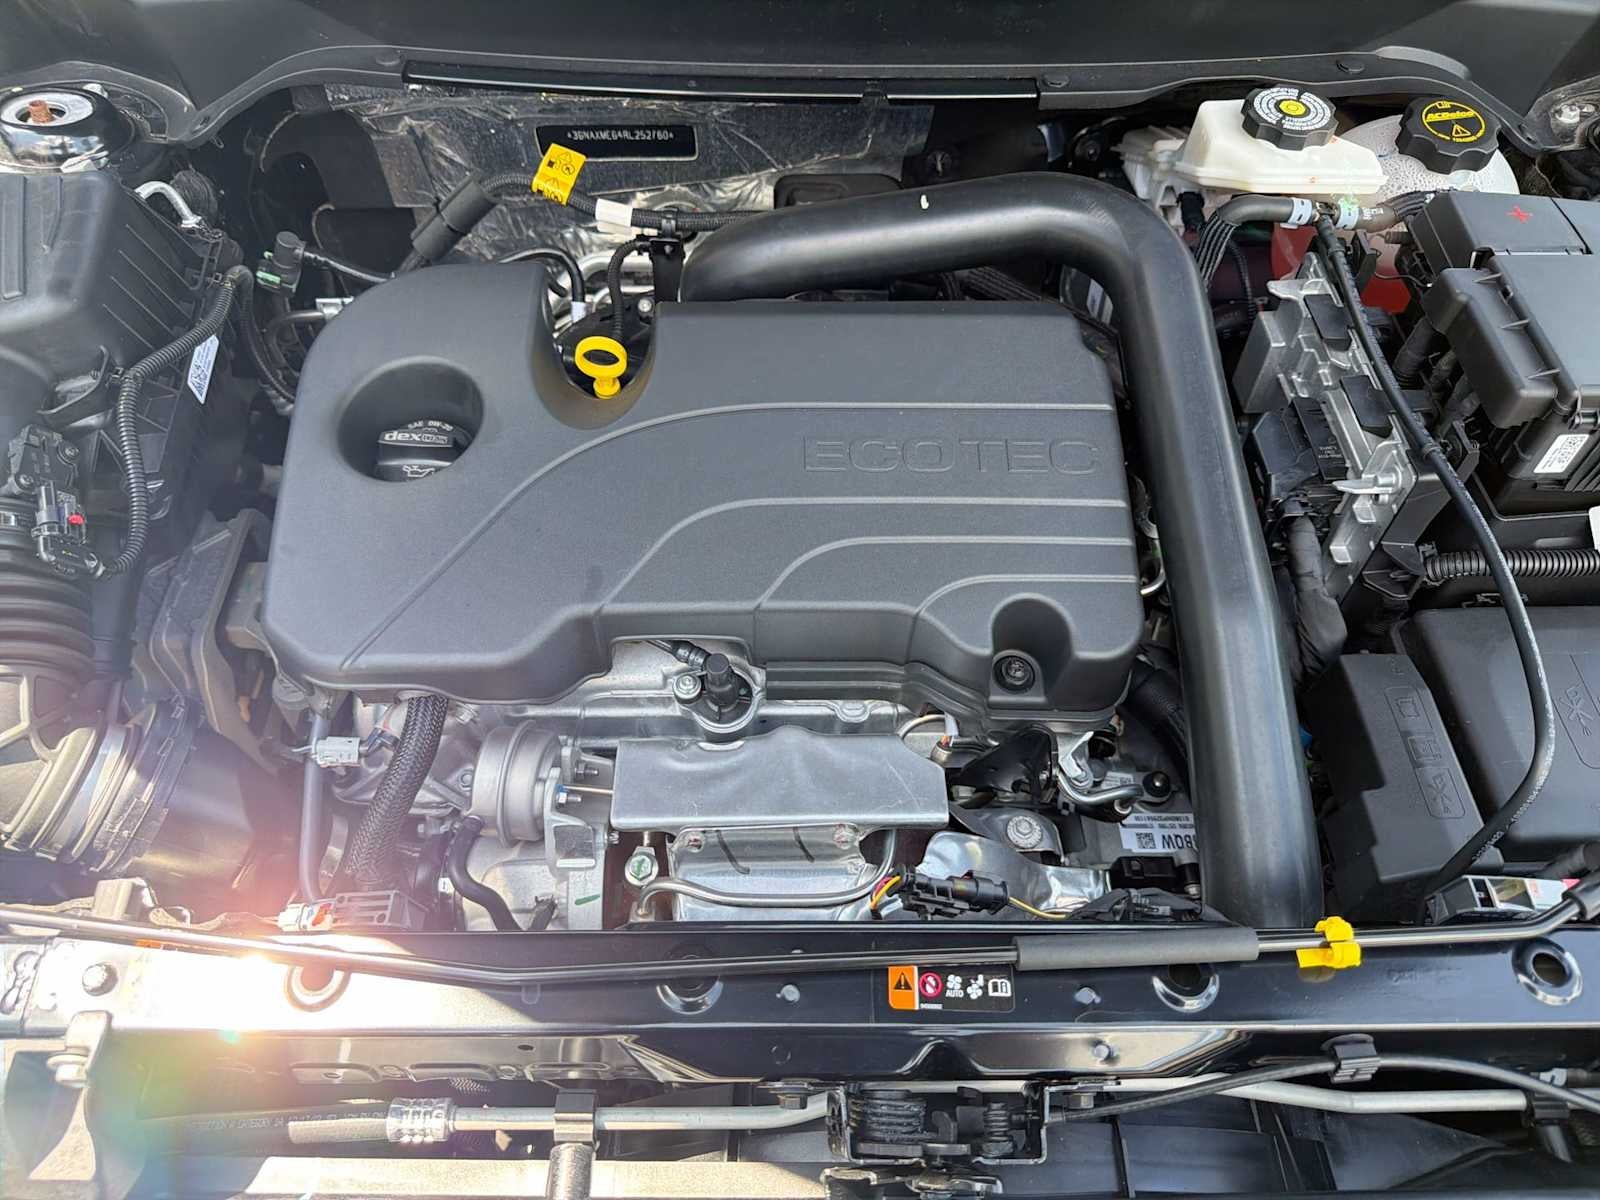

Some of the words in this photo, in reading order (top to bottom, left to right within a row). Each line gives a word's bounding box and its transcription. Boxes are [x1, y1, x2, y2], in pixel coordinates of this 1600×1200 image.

[803, 436, 1099, 475] ECOTEC
[1162, 834, 1196, 849] BQW
[945, 989, 964, 998] AUTO
